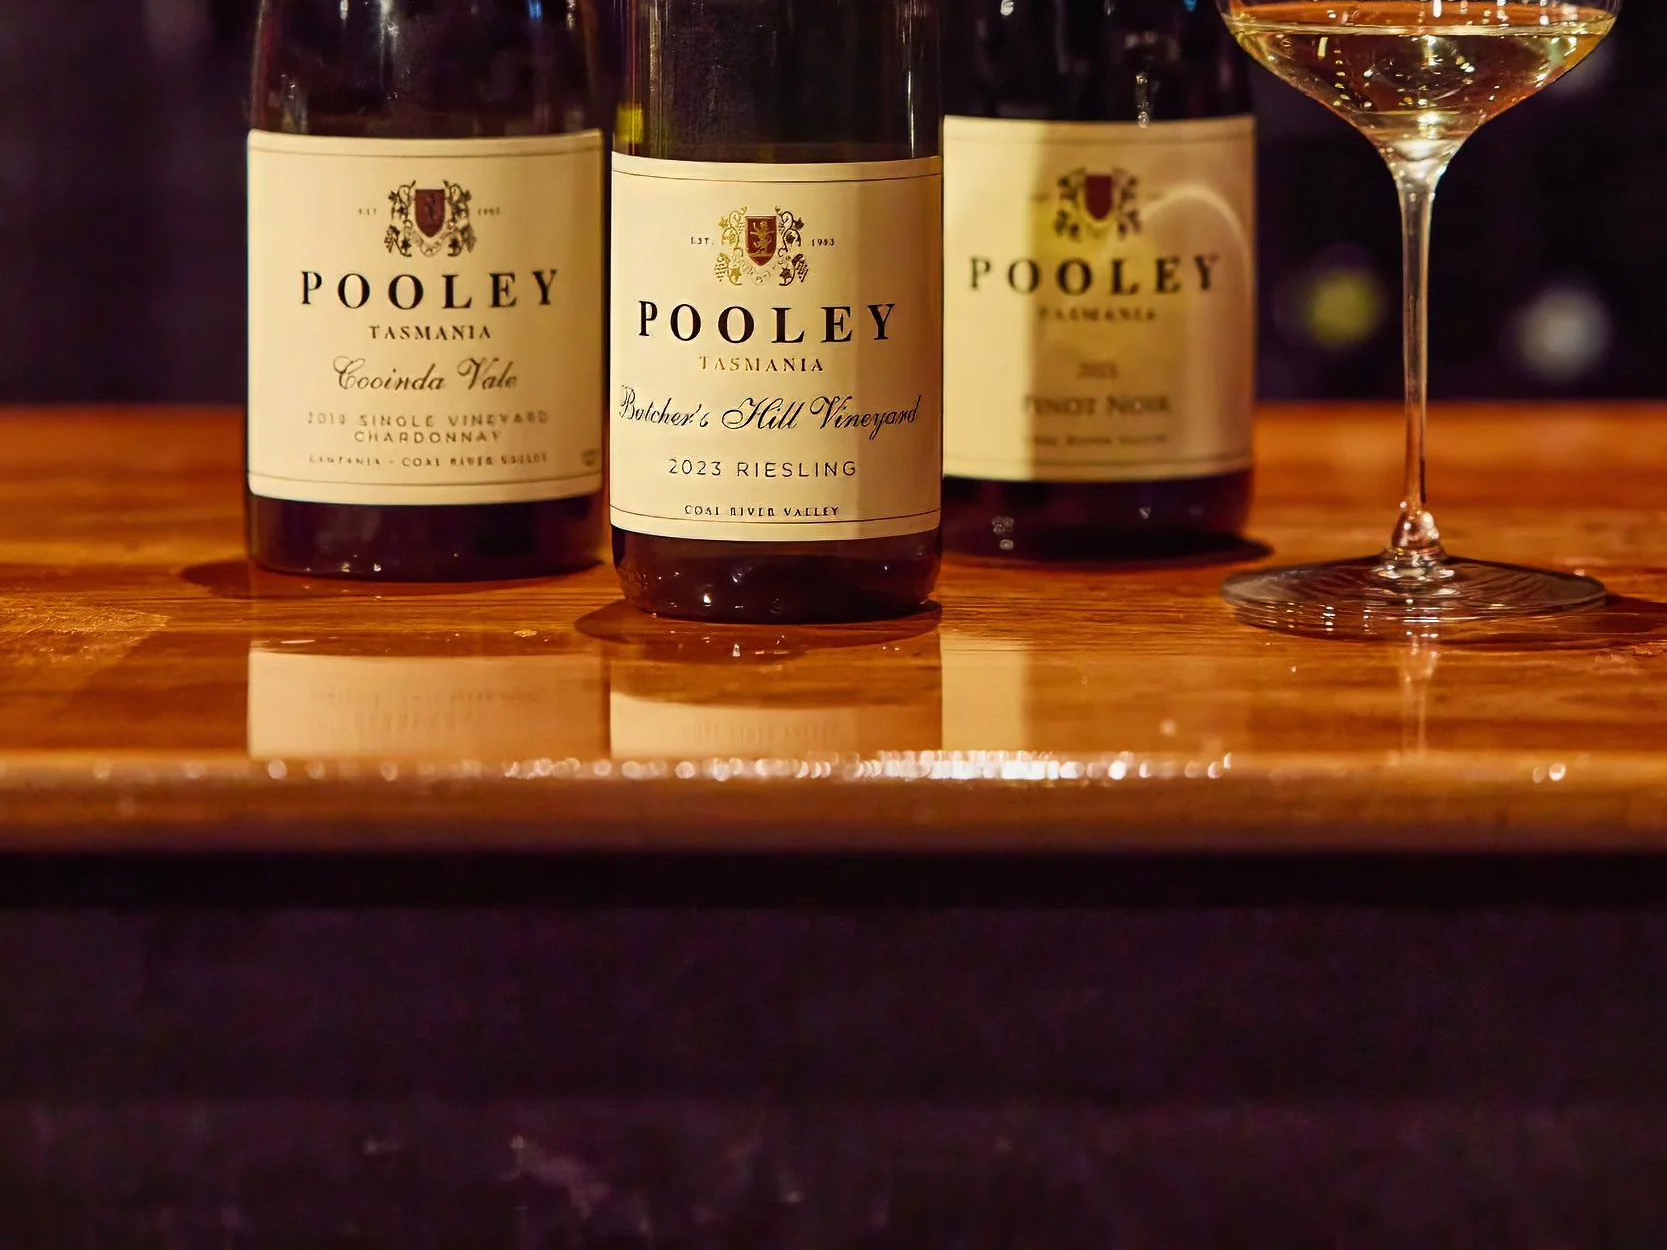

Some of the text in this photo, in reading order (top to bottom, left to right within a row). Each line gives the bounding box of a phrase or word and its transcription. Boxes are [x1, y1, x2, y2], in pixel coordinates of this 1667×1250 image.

[969, 255, 1220, 296] POOLEY
[300, 269, 559, 310] POOLEY
[638, 300, 895, 344] POOLEY
[368, 325, 493, 341] TASMANIA
[333, 355, 518, 392] Cooinda Vale
[699, 356, 824, 373] TASMANIA
[360, 414, 436, 428] SINGLE
[447, 410, 550, 428] VINEYARD
[721, 396, 804, 431] Hill
[809, 394, 922, 441] Vineyard
[354, 430, 503, 445] CHARDONNAY
[668, 458, 857, 478] 2023 RIESLING
[783, 505, 840, 517] VALLEY
